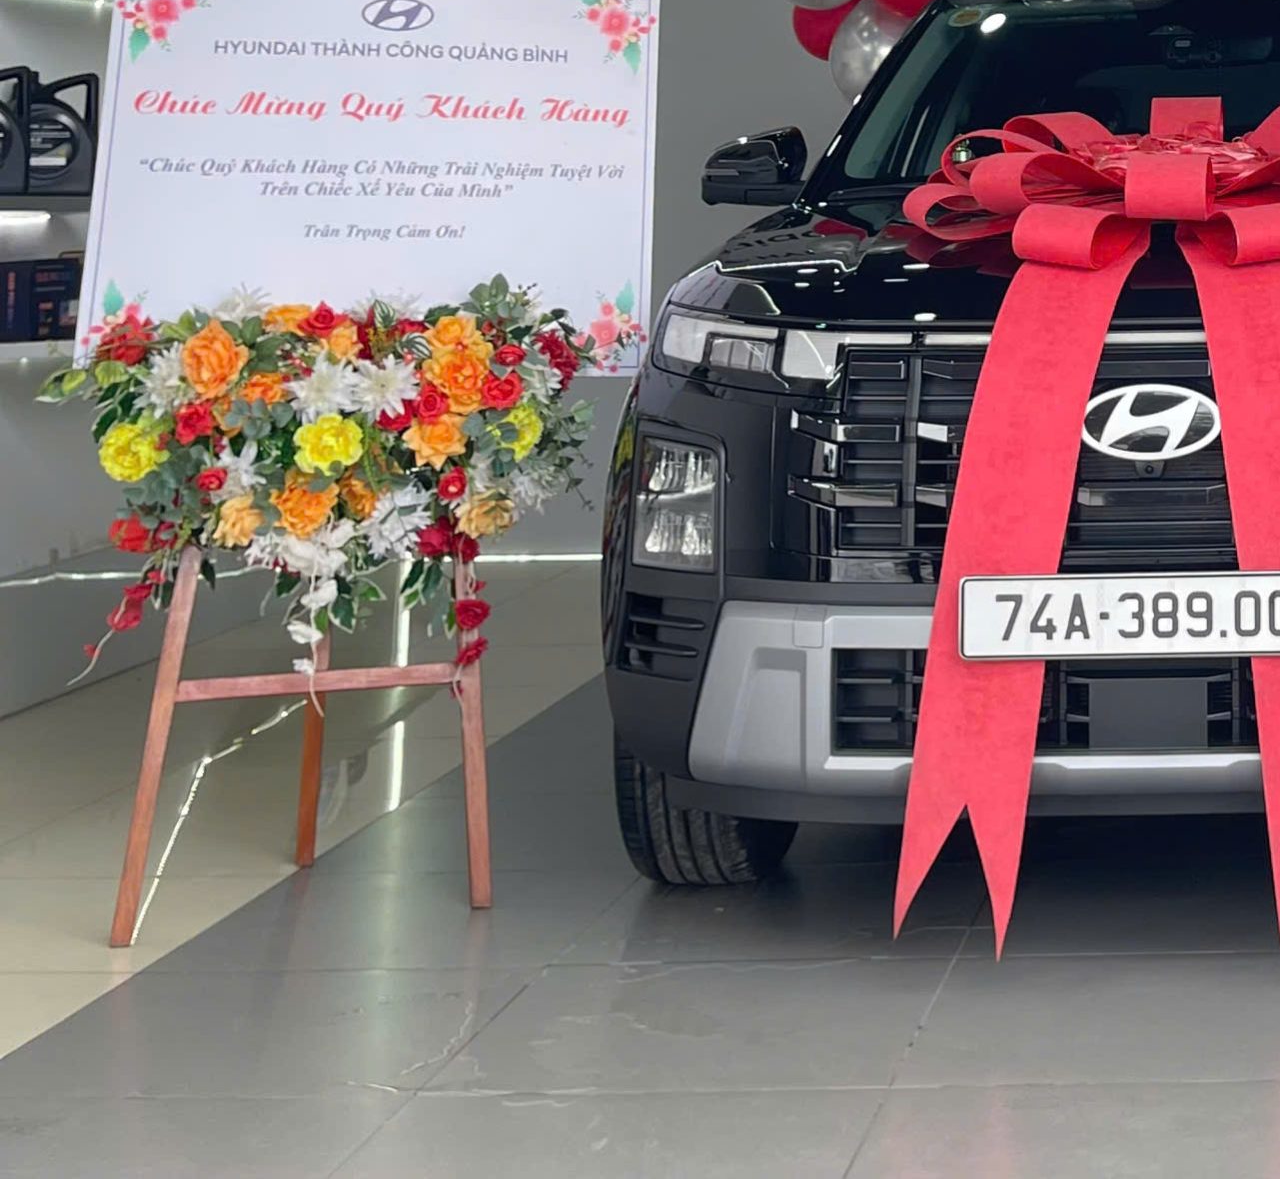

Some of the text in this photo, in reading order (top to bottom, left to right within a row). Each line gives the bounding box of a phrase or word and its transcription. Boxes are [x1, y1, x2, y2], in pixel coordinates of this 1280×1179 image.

[213, 38, 569, 64] HYUNDAI THÀNH CÔNG QUẢNG BÌNH
[133, 89, 632, 129] Chúc Mừng Quý Khách Hàng
[240, 158, 296, 174] Khách
[301, 159, 349, 178] Hàng
[353, 159, 377, 175] Có
[382, 159, 440, 179] Những
[483, 161, 545, 181] Nghiệm
[550, 163, 593, 182] Tuyệt
[259, 180, 299, 197] Trên
[304, 178, 353, 197] Chiếc
[384, 181, 416, 198] Yêu
[420, 182, 455, 198] Của
[303, 223, 341, 239] Trân
[346, 223, 392, 241] Trọng
